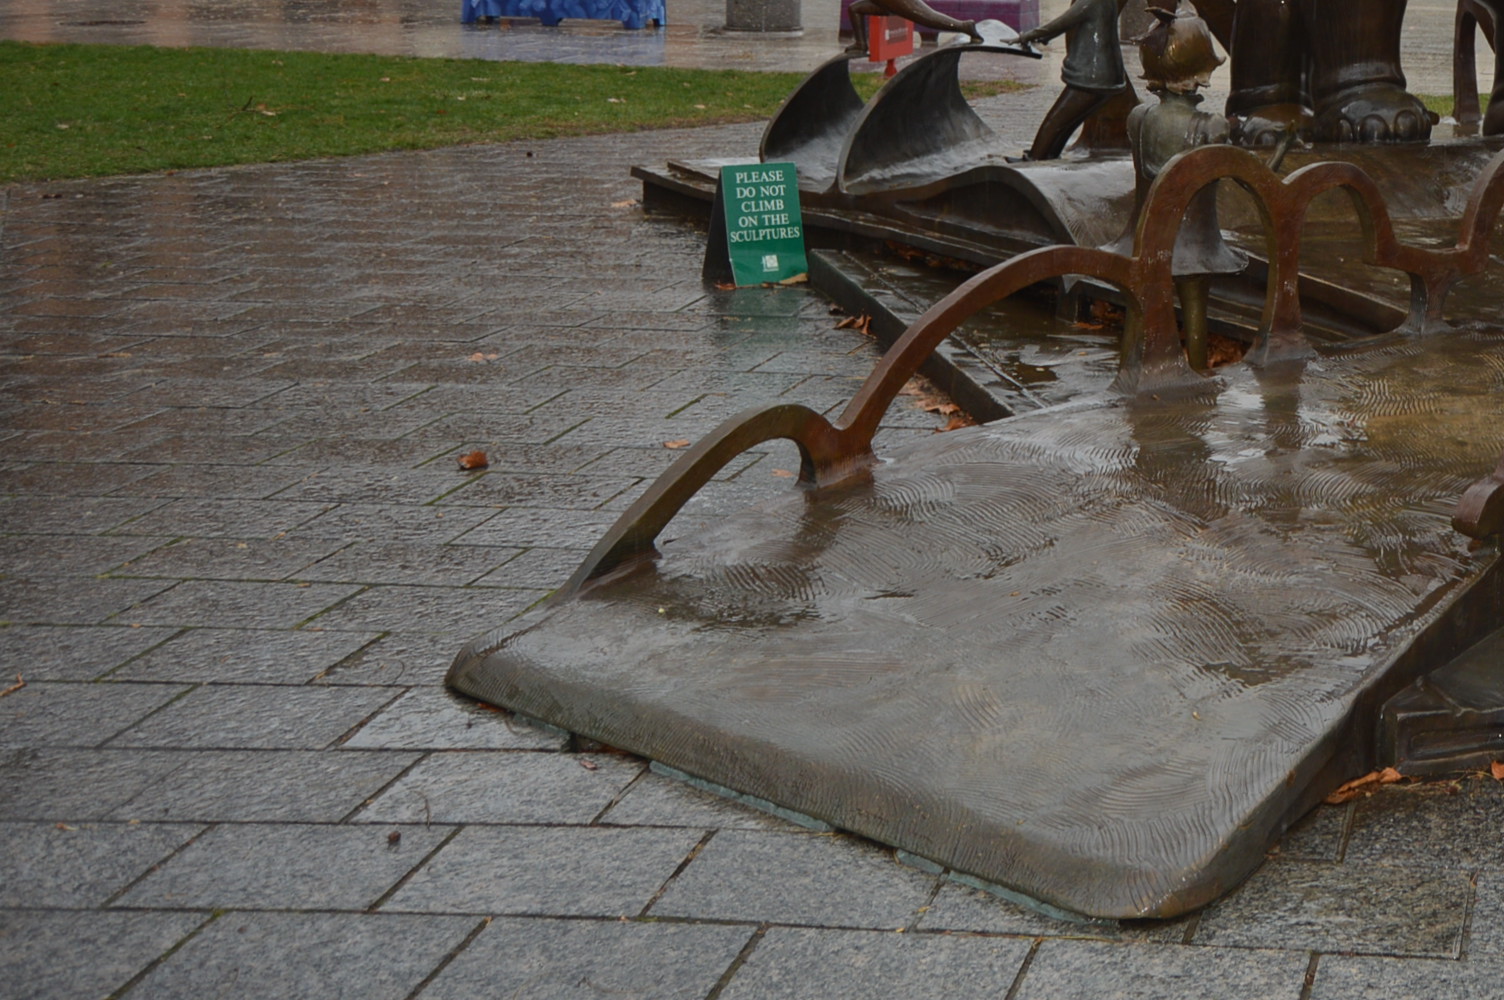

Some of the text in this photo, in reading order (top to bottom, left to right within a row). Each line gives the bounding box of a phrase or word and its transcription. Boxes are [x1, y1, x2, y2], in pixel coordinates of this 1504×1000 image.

[735, 170, 784, 184] PLEASE
[736, 184, 786, 199] DO NOT
[741, 199, 784, 213] CLIMB
[738, 213, 790, 228] ON THE
[730, 226, 801, 243] SCULPTURES
